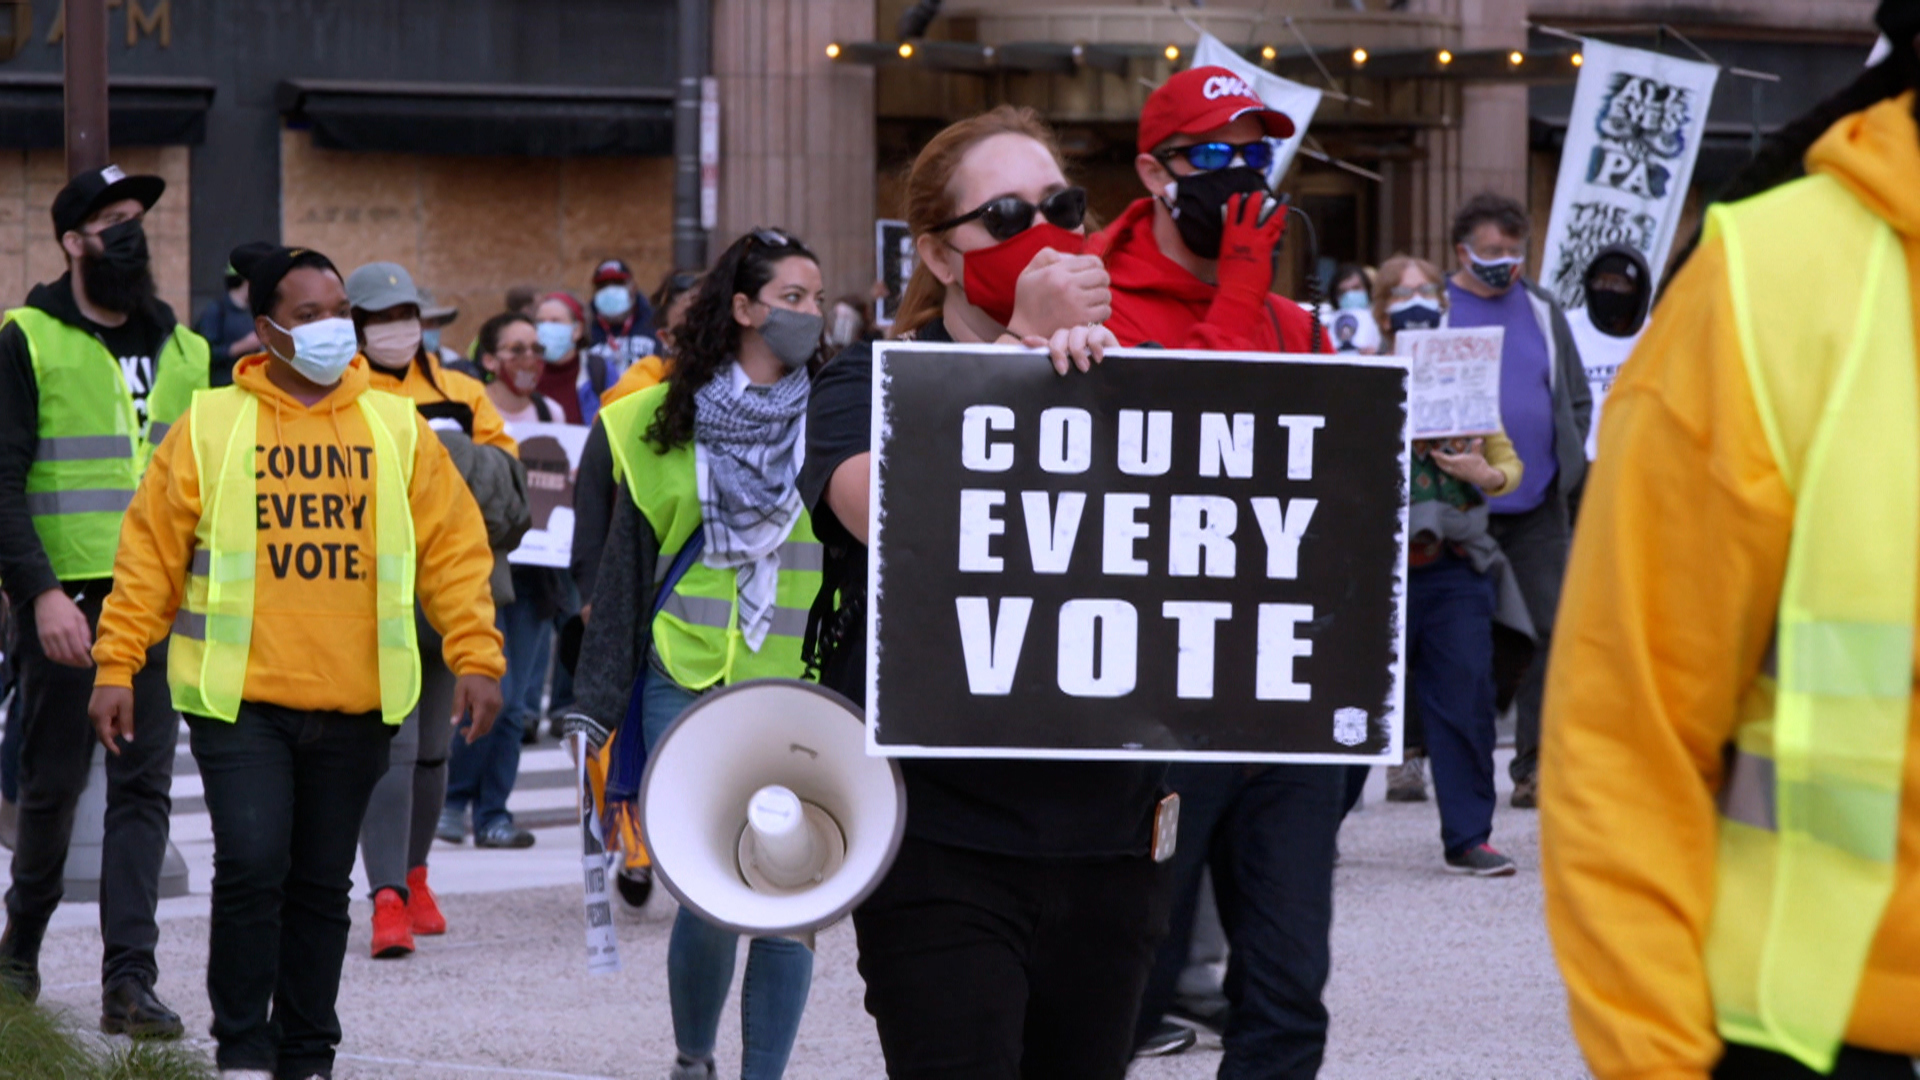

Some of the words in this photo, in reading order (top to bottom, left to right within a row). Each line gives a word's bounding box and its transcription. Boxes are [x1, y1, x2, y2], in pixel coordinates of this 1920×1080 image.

[1595, 151, 1654, 198] PA
[1571, 202, 1628, 225] THE
[244, 444, 373, 480] COUNT
[961, 405, 1326, 480] COUNT
[256, 493, 367, 530] EVERY
[958, 489, 1319, 579] EVERY
[955, 596, 1314, 701] VOTE
